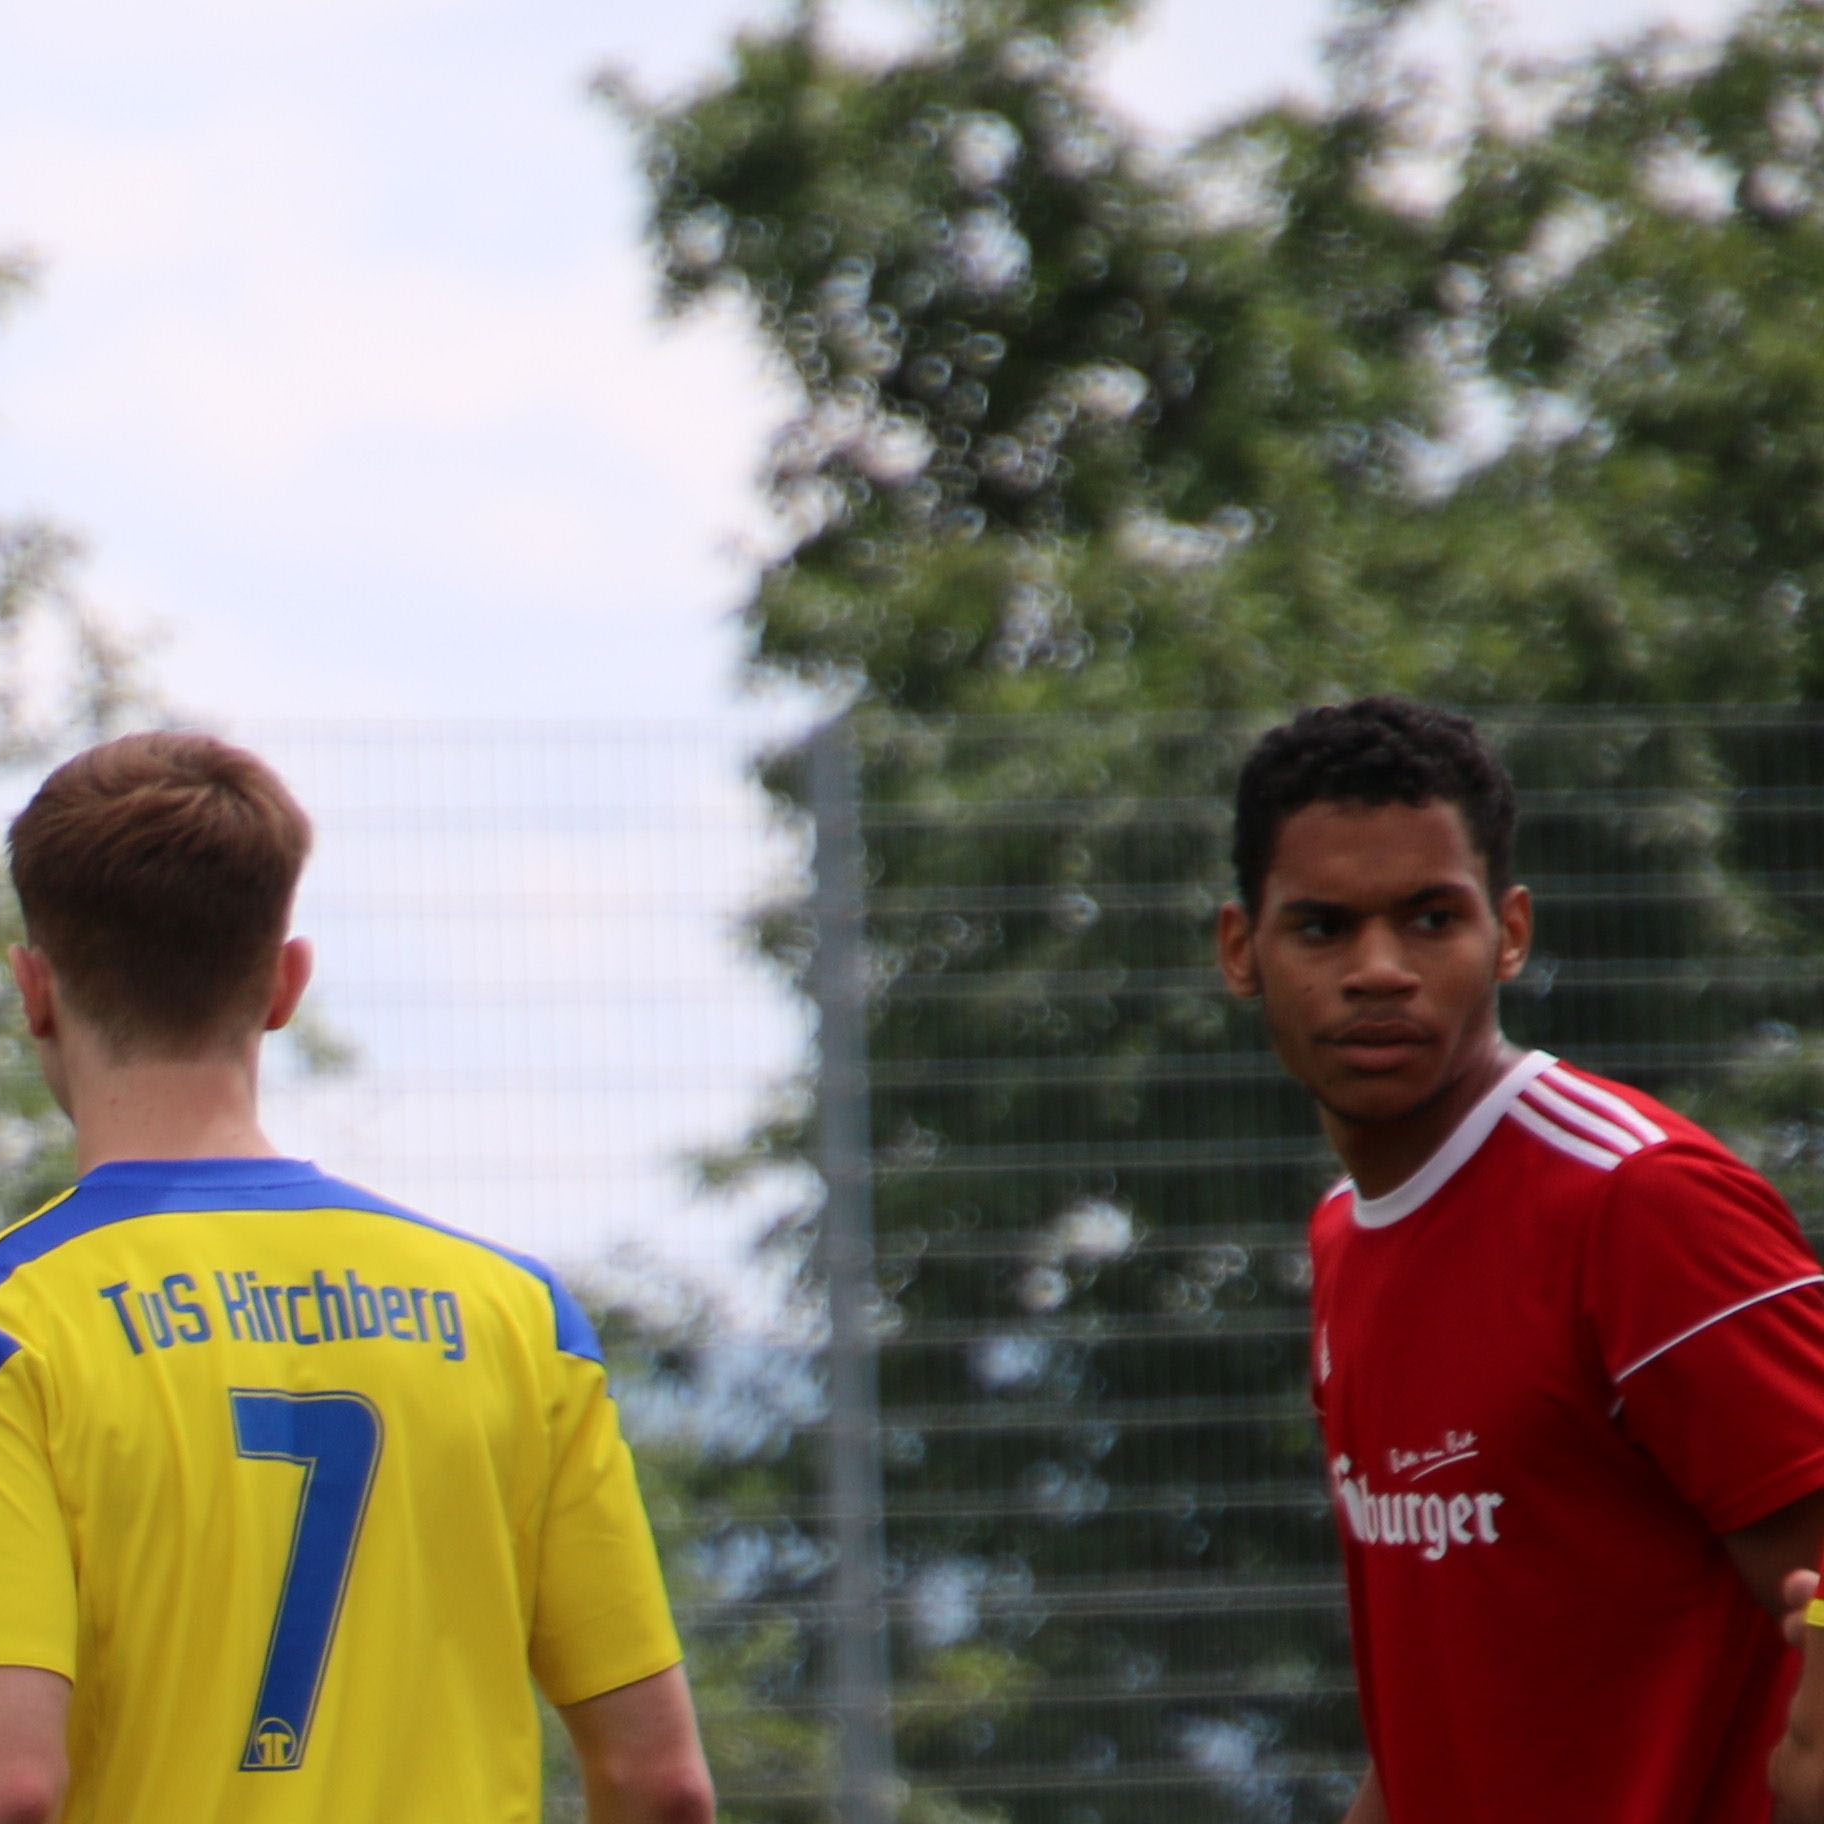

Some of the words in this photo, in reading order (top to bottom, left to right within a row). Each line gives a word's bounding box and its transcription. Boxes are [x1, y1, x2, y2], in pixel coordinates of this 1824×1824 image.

[98, 1273, 212, 1357] TuS
[214, 1269, 466, 1361] Kirchberg
[228, 1387, 386, 1772] 7
